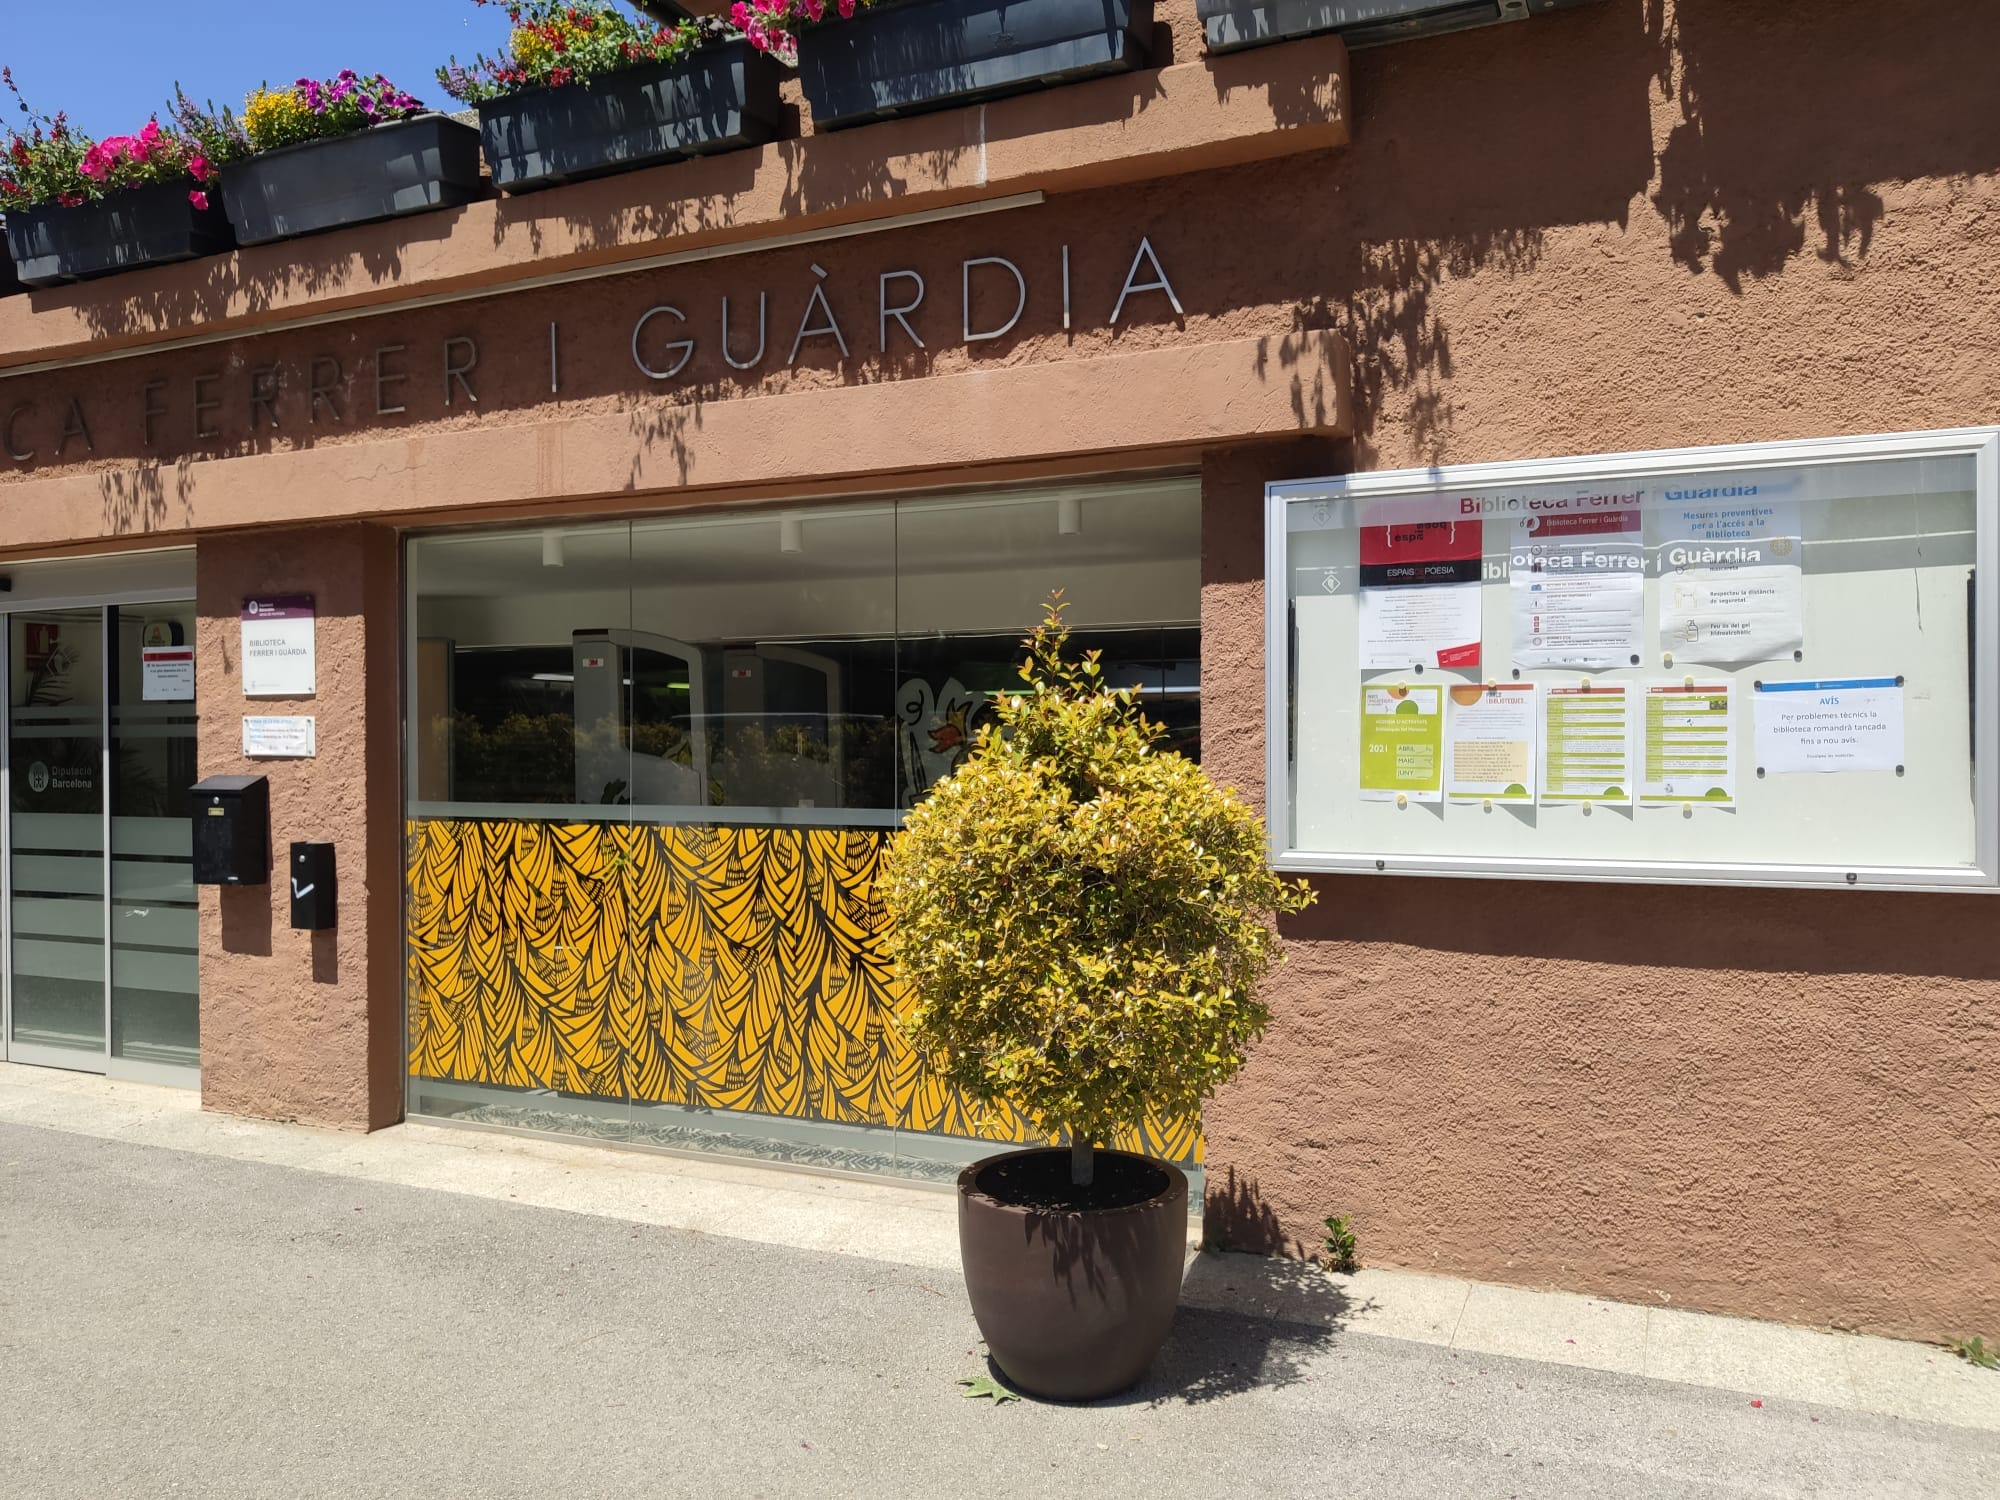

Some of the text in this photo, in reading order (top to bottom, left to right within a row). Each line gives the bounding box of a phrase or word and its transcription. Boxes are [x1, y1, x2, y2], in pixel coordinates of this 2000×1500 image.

[142, 336, 479, 447] FERRER
[550, 320, 559, 394] I
[631, 235, 1184, 380] GUÀRDIA
[1683, 508, 1773, 520] Mesures preventives
[1691, 522, 1706, 531] per
[1756, 518, 1765, 526] la
[1705, 530, 1751, 539] Biblioteca
[1581, 551, 1649, 572] Ferrer
[1669, 547, 1761, 566] Guàrdia
[1386, 568, 1415, 577] ESPAIS
[1424, 566, 1455, 575] POESIA
[249, 639, 286, 647] BIBLIOTECA
[249, 649, 274, 657] FERRER
[278, 647, 307, 656] GUÀRDIA
[1819, 696, 1840, 705] AVÍS
[1796, 712, 1838, 721] problemes
[1840, 710, 1868, 718] tècnics
[1870, 710, 1877, 718] la
[1773, 723, 1886, 733] biblioteca romandrà tancada
[1800, 737, 1814, 745] fins
[1369, 743, 1388, 753] 2021
[52, 766, 92, 777] Diputació
[52, 778, 92, 789] Barcelona
